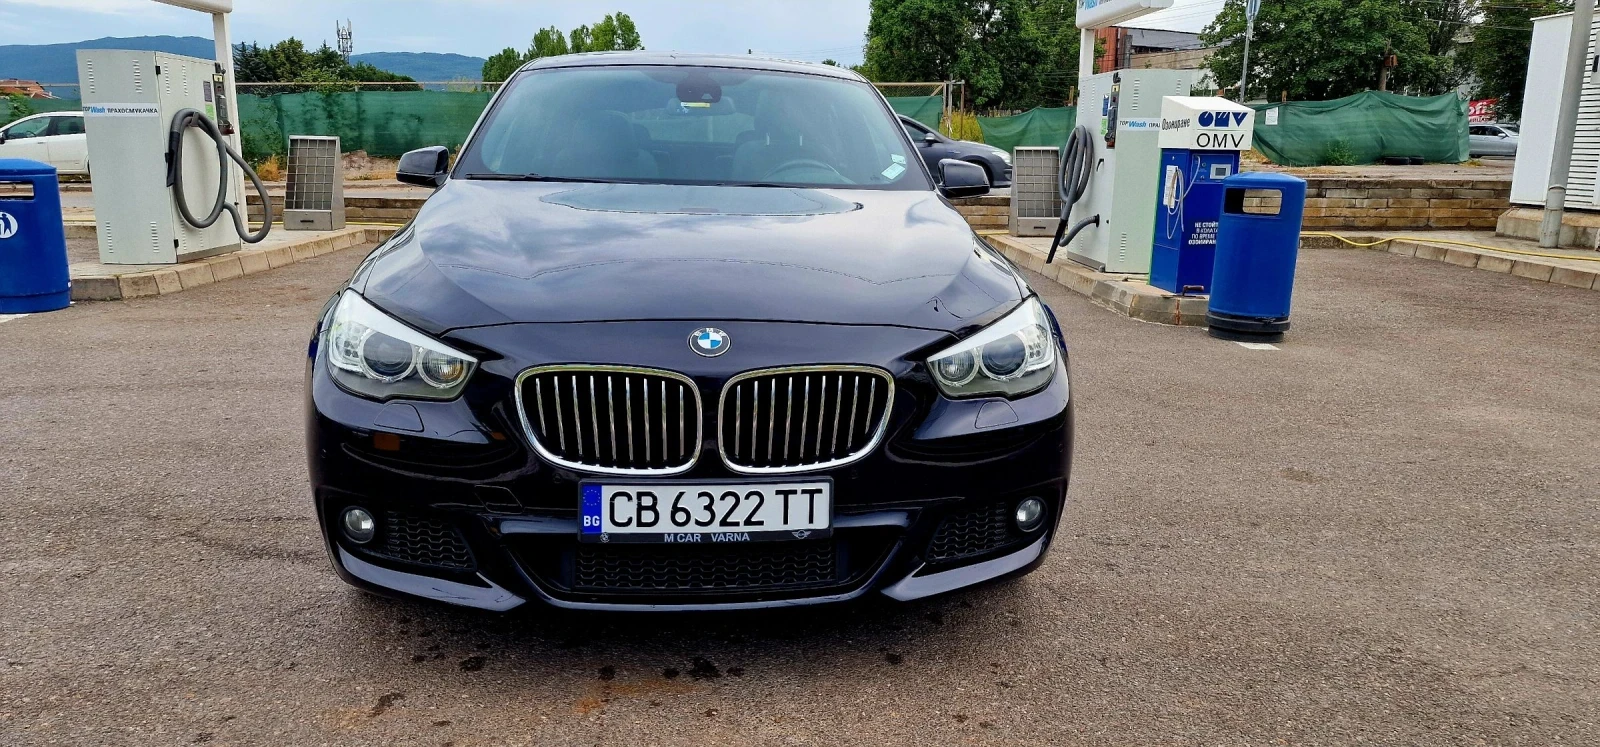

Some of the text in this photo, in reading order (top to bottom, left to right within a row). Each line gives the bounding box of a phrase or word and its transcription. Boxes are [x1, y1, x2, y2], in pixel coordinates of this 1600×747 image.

[1128, 120, 1147, 128] Wash
[1198, 111, 1248, 127] OMV
[1196, 133, 1244, 148] OMV
[608, 488, 823, 528] CB 6322 TT
[583, 515, 600, 527] BG
[664, 532, 750, 543] M CAR VARNA
